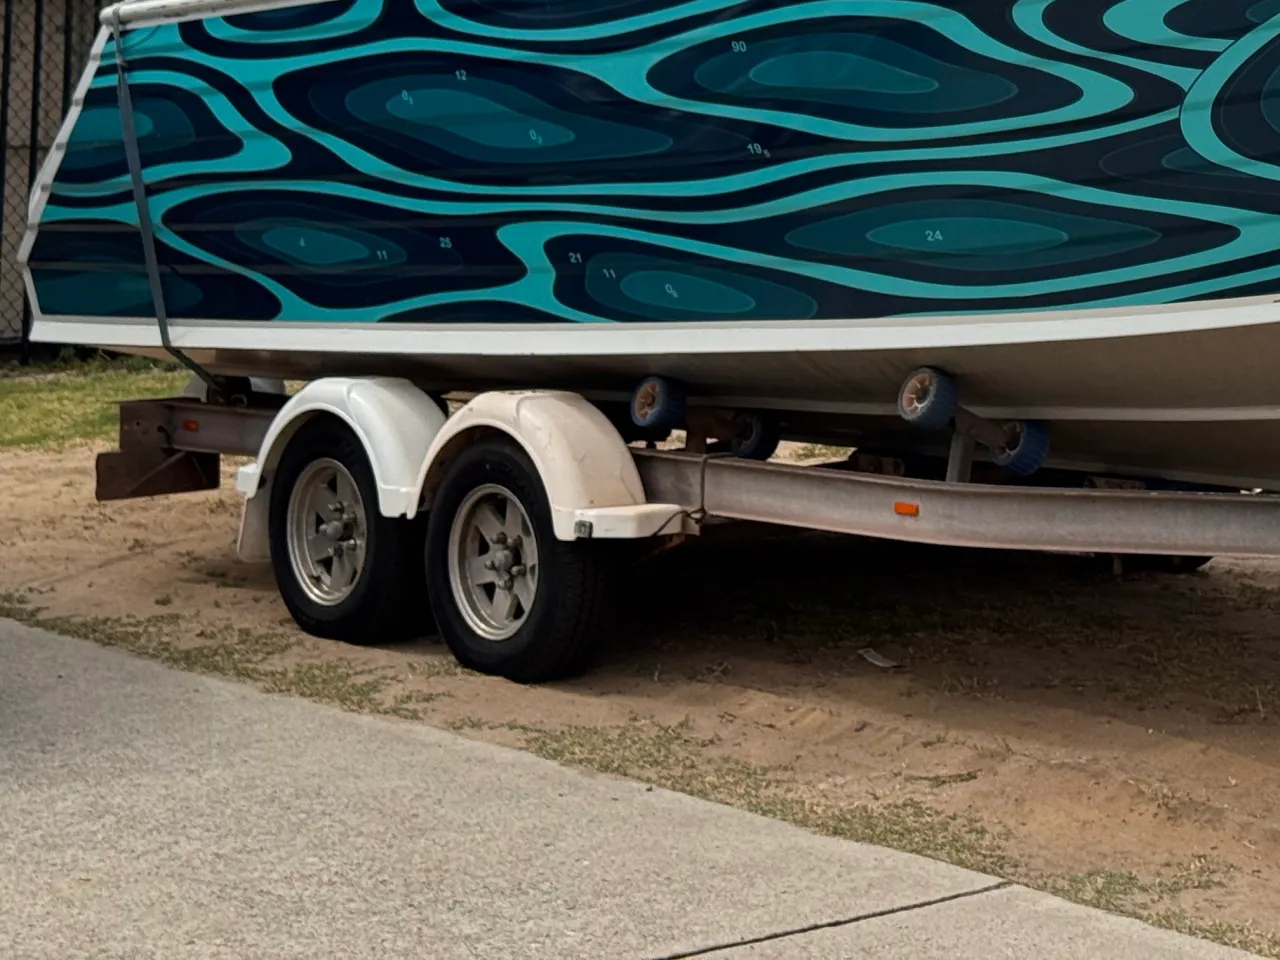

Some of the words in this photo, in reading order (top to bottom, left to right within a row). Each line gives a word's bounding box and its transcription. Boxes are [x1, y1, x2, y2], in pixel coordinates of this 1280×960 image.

[731, 40, 746, 52] 90
[455, 69, 467, 81] 12
[924, 230, 943, 241] 24
[376, 250, 388, 261] 11
[568, 252, 582, 263] 21
[602, 268, 616, 280] 11
